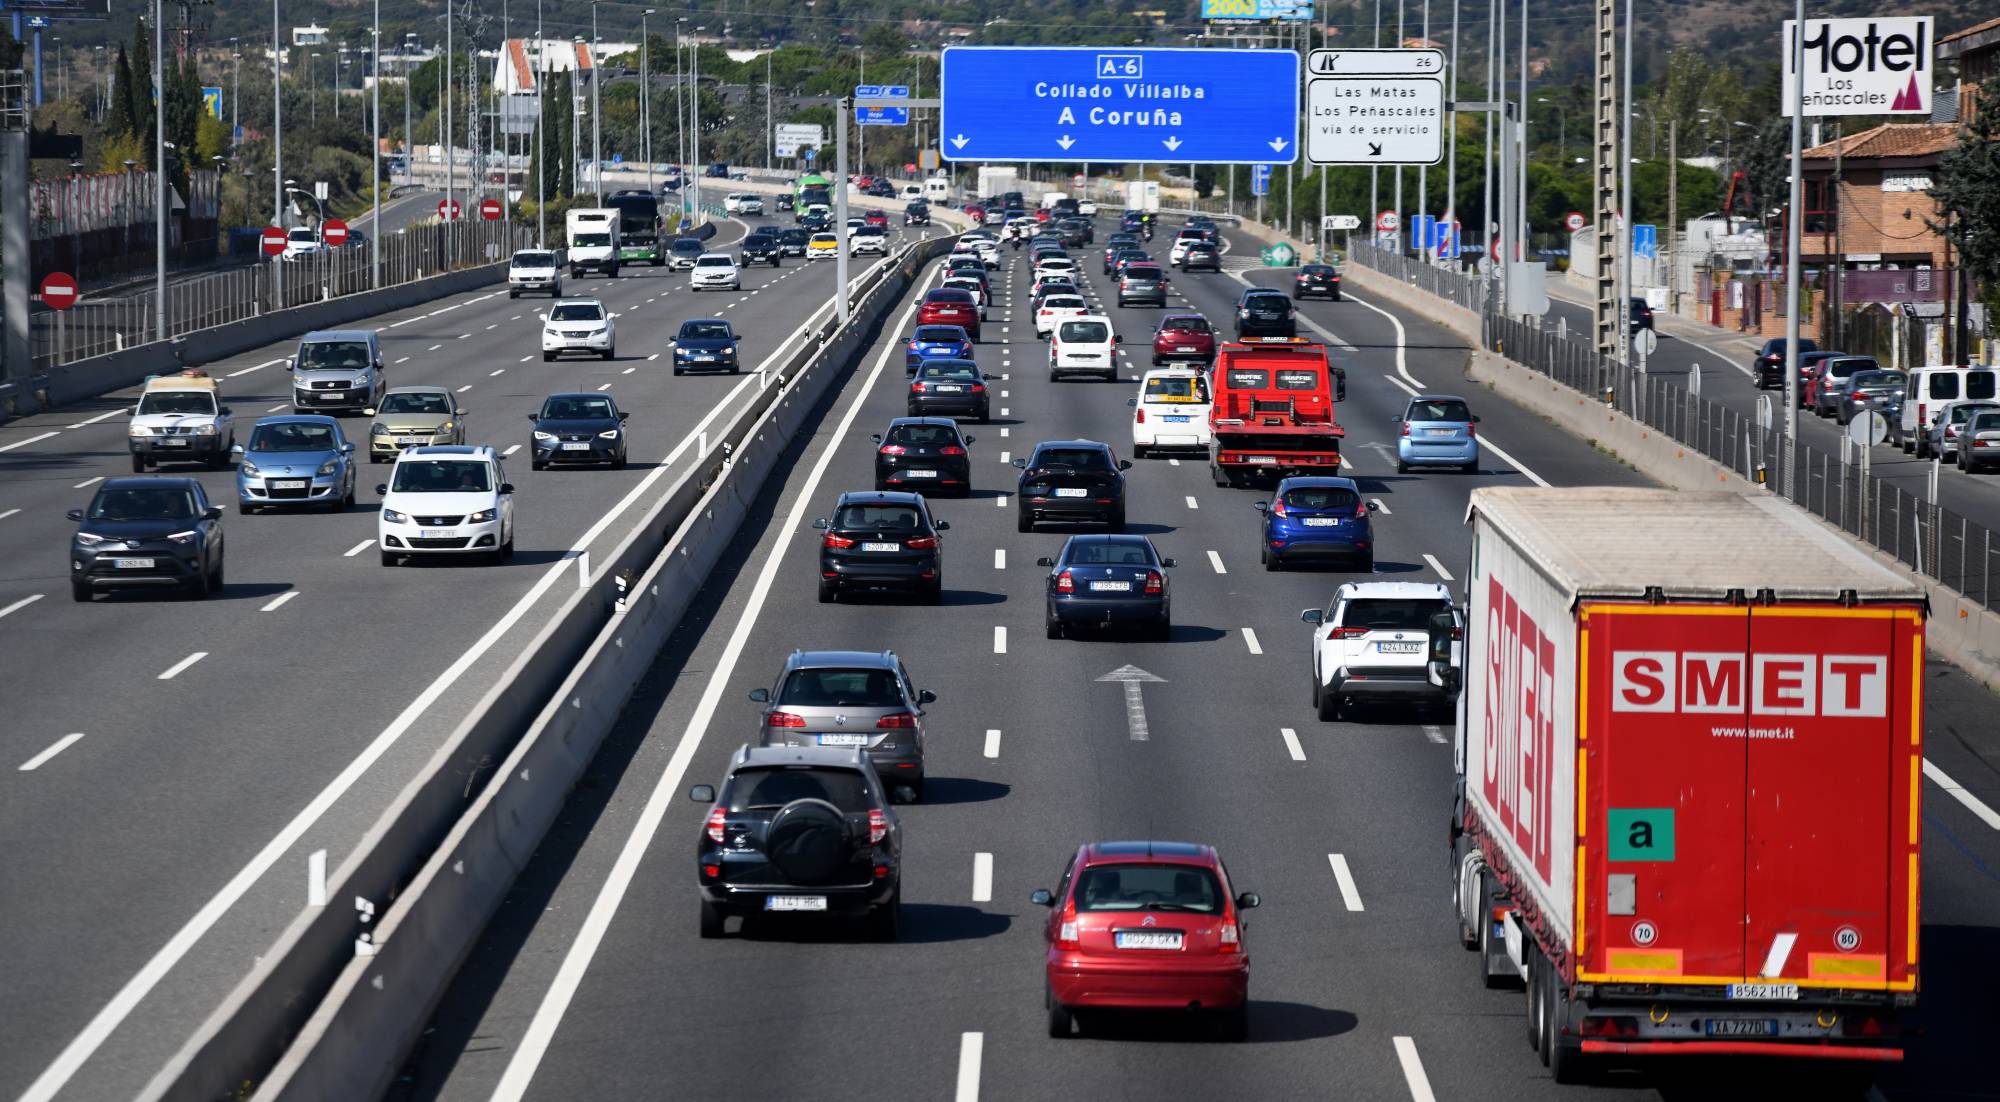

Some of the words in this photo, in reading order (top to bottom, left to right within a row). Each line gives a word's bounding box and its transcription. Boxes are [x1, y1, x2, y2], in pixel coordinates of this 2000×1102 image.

[1791, 21, 1926, 75] Hotel
[1102, 58, 1138, 75] A-6
[1416, 57, 1432, 67] 26
[1827, 77, 1853, 90] Los
[1035, 82, 1113, 99] Collado
[1123, 83, 1205, 100] Villalba
[1335, 86, 1362, 98] Las
[1370, 86, 1417, 98] Matas
[1802, 90, 1888, 106] eñascales
[1057, 106, 1076, 126] A
[1089, 107, 1183, 127] Coruña
[1315, 105, 1341, 117] Los
[1348, 105, 1437, 117] Peñascales
[1349, 124, 1365, 135] de
[1372, 124, 1430, 135] servicio
[1382, 643, 1402, 652] 4241
[1404, 643, 1420, 652] KXZ
[1621, 657, 1877, 710] SMET
[1485, 607, 1552, 857] SMET
[1711, 725, 1795, 739] www.smet.it
[1628, 819, 1653, 849] a
[1638, 927, 1651, 939] 70
[1840, 933, 1854, 945] 80
[1735, 985, 1767, 998] 8562
[1712, 1020, 1729, 1035] XA
